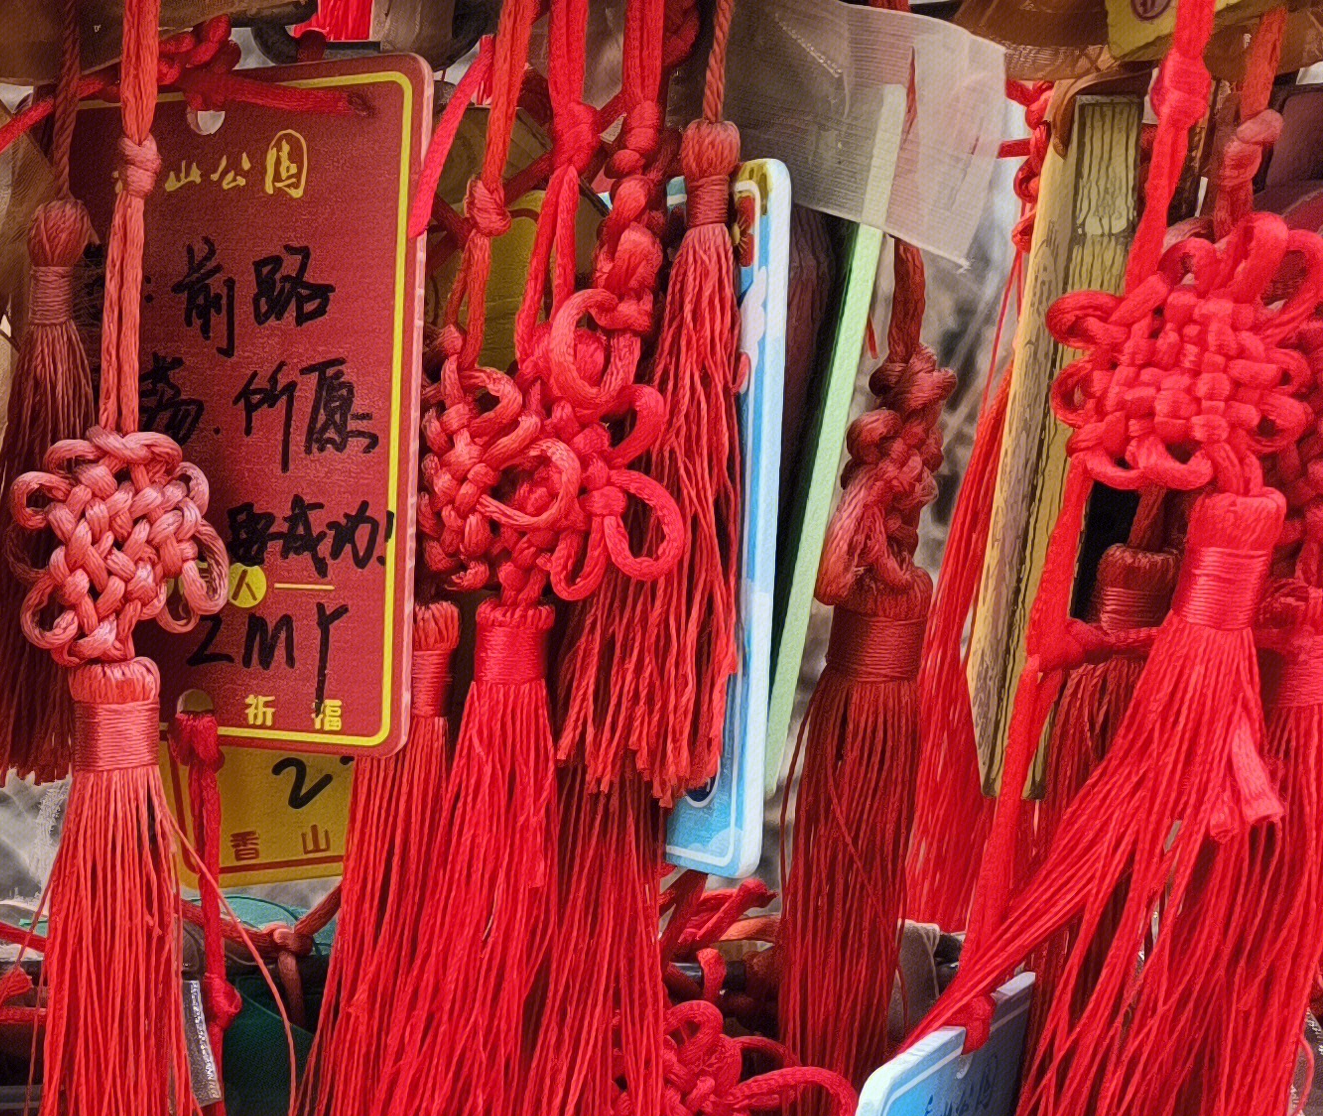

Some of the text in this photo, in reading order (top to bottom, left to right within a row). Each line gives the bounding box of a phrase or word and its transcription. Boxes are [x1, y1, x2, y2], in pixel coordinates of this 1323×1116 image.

[112, 129, 307, 198] 山公园
[171, 236, 335, 358] 前路
[245, 694, 342, 731] 祈福
[229, 823, 332, 862] 香山
